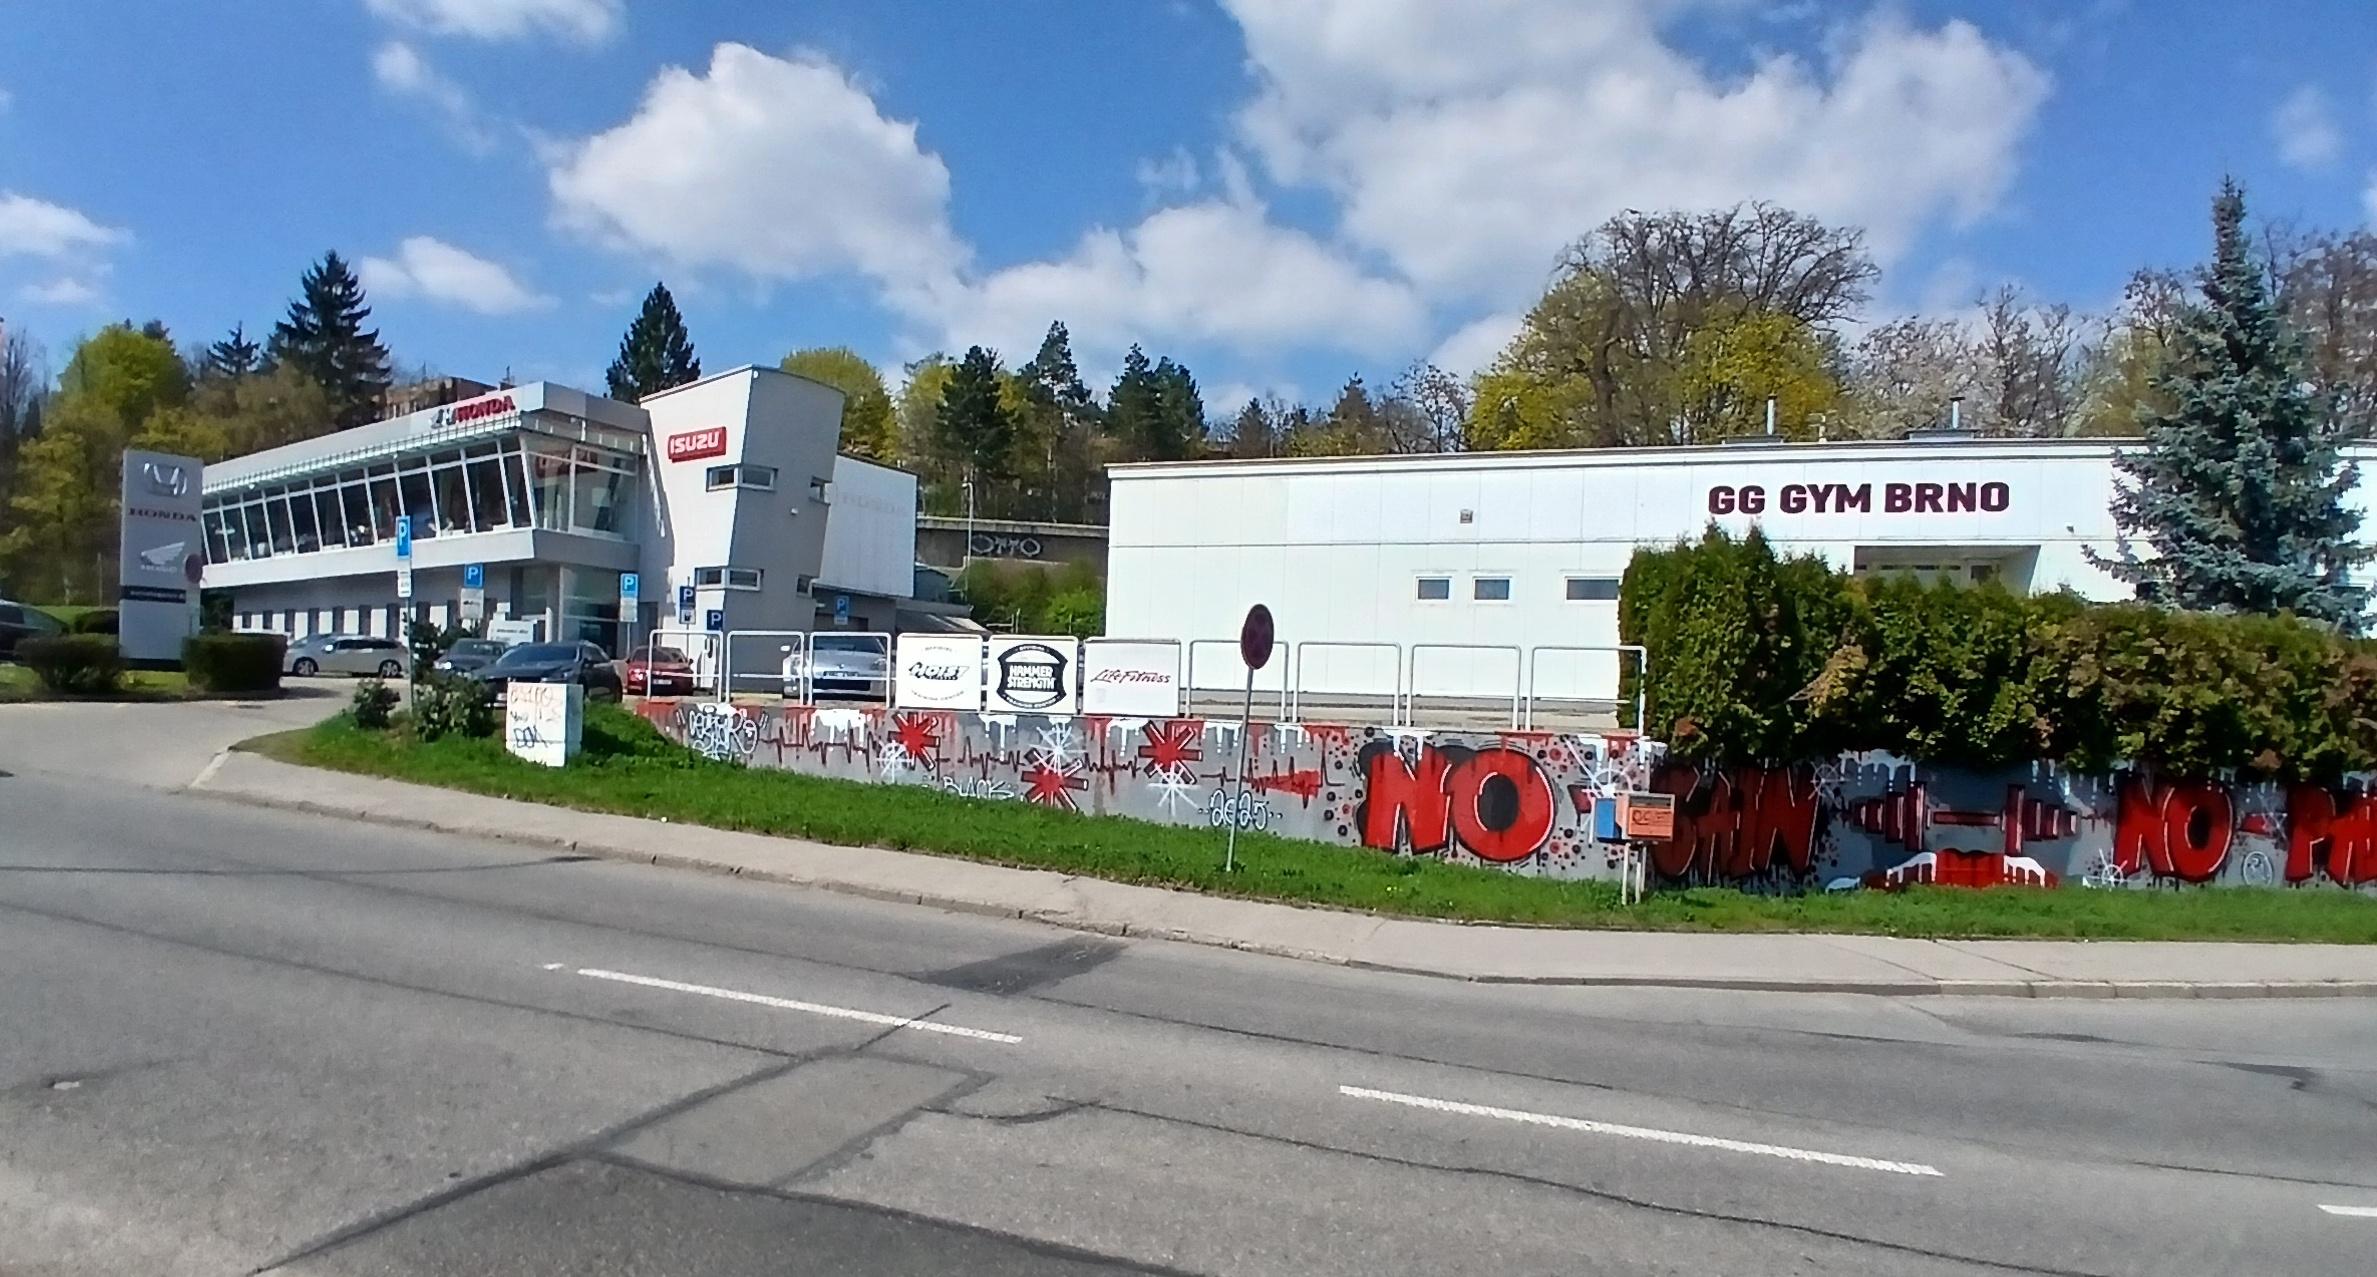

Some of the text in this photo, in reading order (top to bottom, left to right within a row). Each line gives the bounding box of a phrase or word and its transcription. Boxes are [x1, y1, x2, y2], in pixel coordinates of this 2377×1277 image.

[456, 395, 516, 422] HONDA
[670, 431, 720, 454] ISUZU
[1708, 482, 2010, 515] GG GYM BRNO
[129, 507, 197, 522] HONDA
[399, 521, 408, 546] P
[467, 567, 479, 580] P
[623, 576, 634, 590] P
[683, 588, 694, 601] P
[710, 612, 721, 626] P
[1009, 665, 1054, 678] HAMMER
[1007, 677, 1057, 689] STRENGTH
[1363, 743, 1555, 862] NO
[2113, 774, 2236, 883] NO
